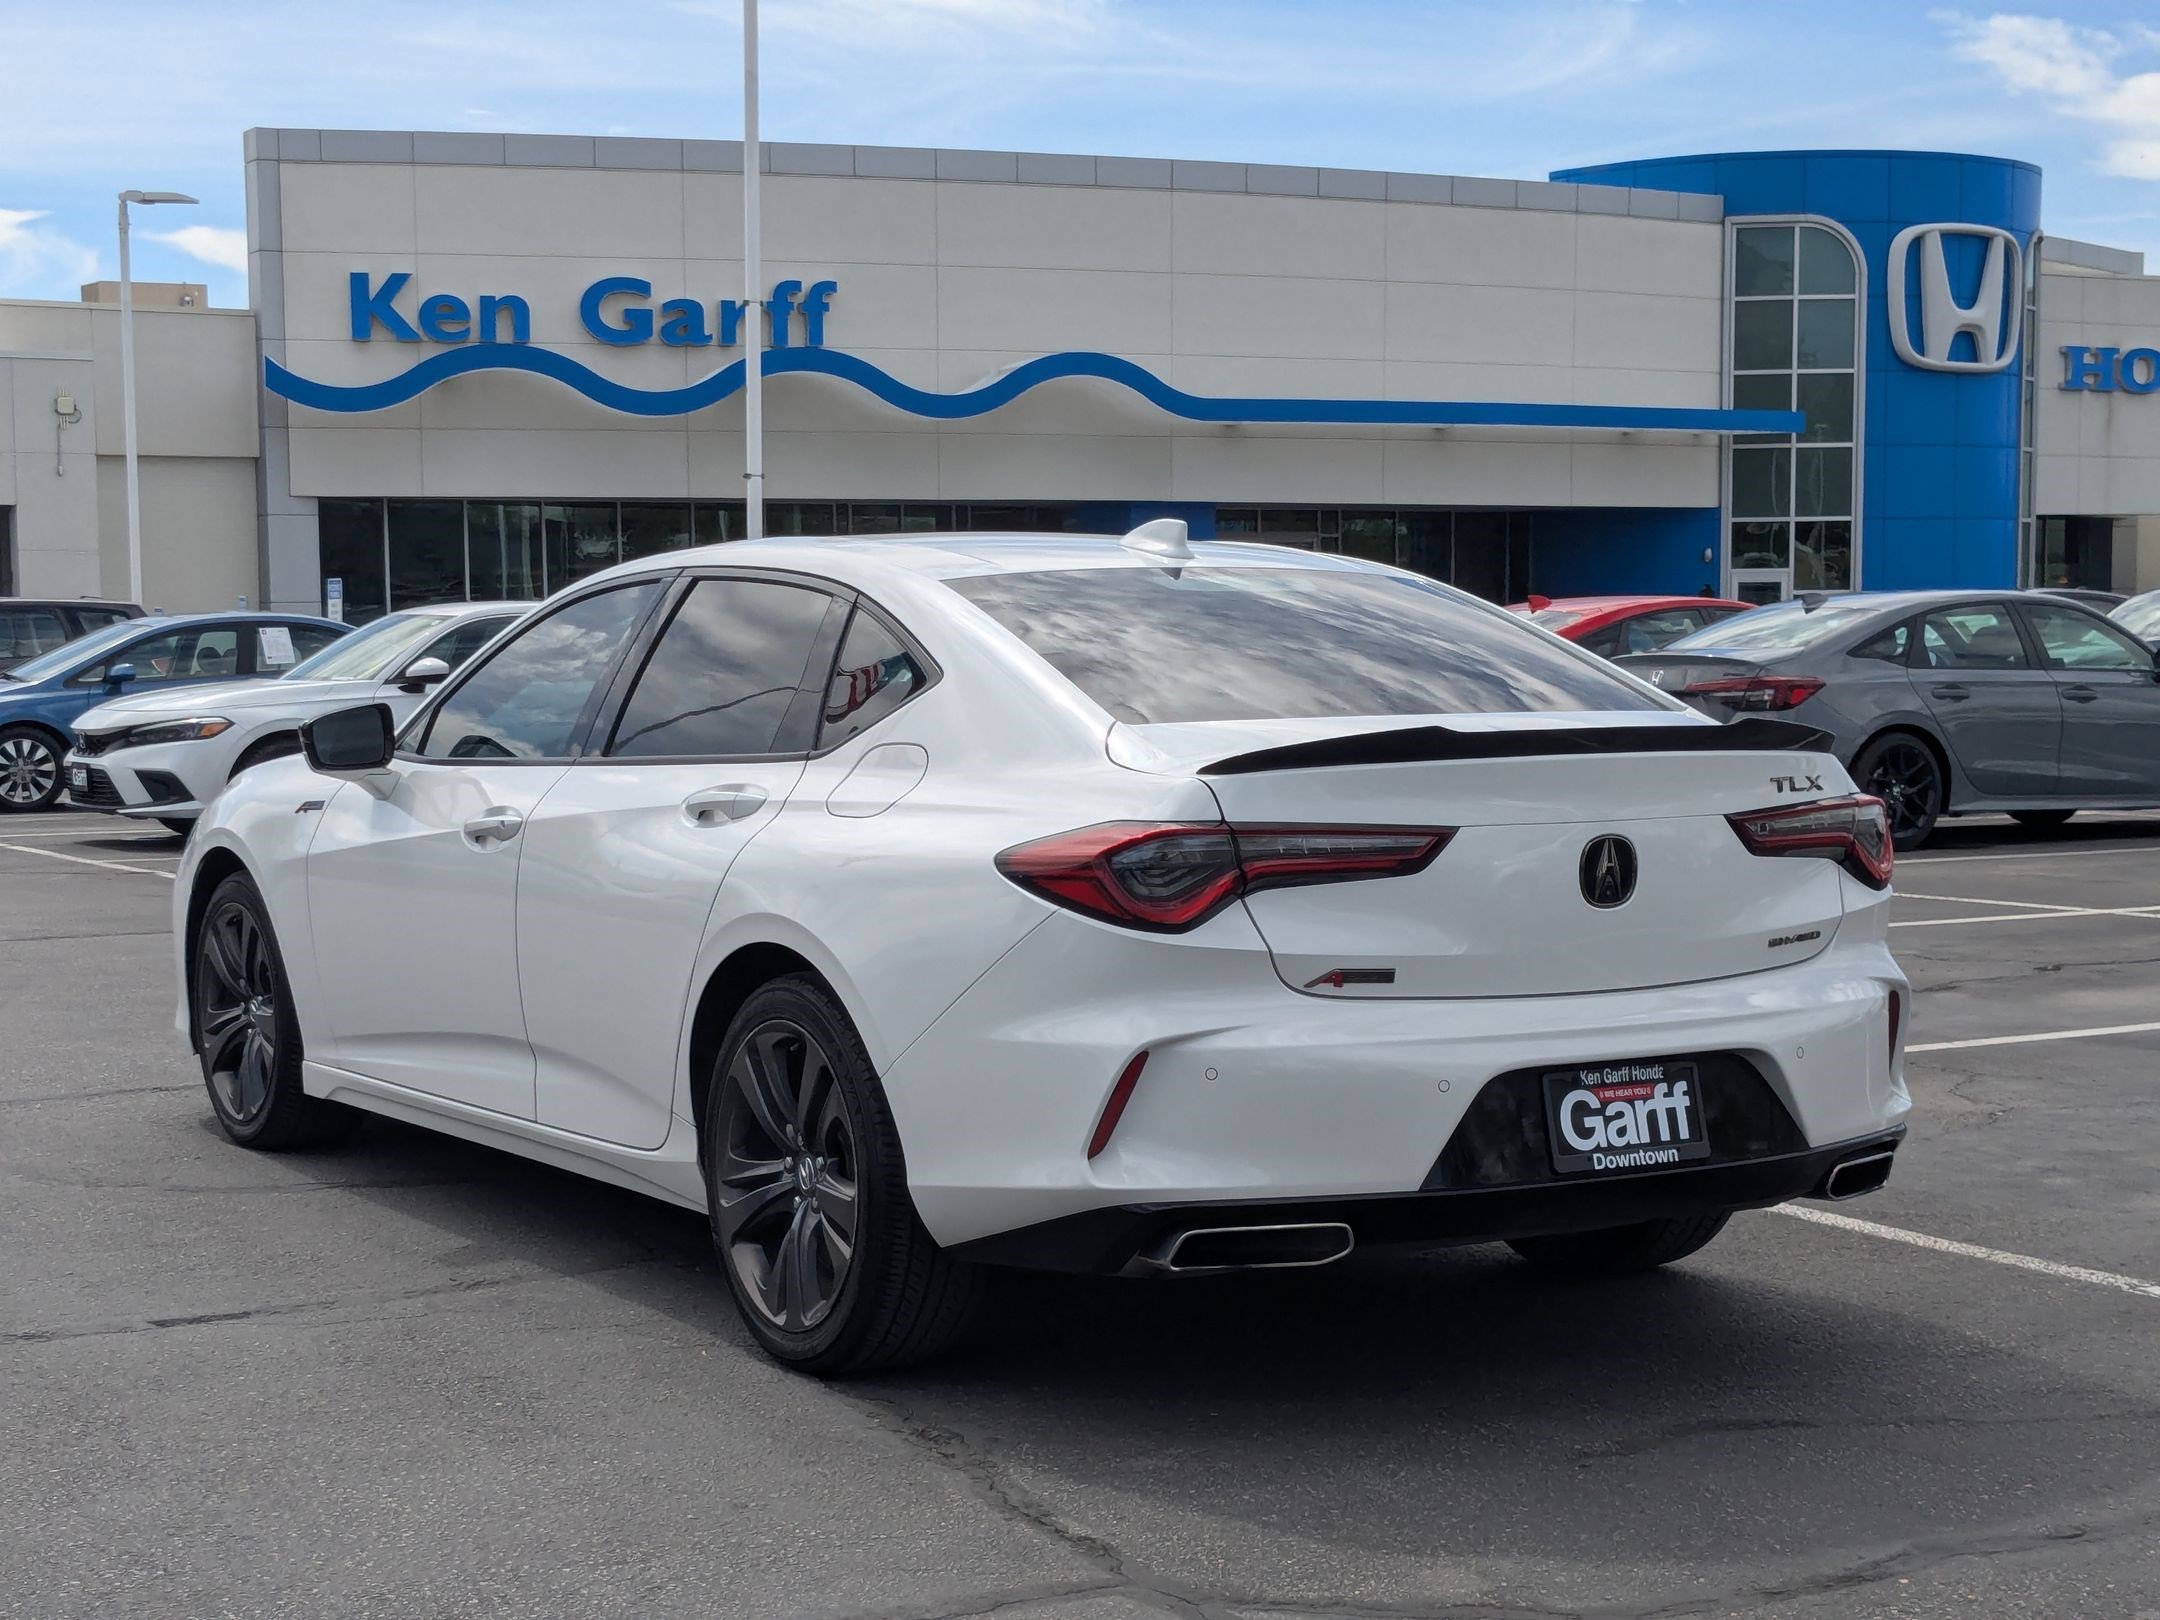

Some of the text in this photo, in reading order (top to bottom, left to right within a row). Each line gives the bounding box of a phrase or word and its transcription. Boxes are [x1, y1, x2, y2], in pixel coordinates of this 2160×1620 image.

[349, 271, 838, 347] Ken Garff
[2058, 345, 2160, 395] HO
[1769, 775, 1824, 793] TLX
[1579, 1069, 1601, 1086] Ken
[1603, 1066, 1630, 1084] Garff
[1559, 1080, 1691, 1151] Garff
[1592, 1148, 1680, 1171] Downtown
